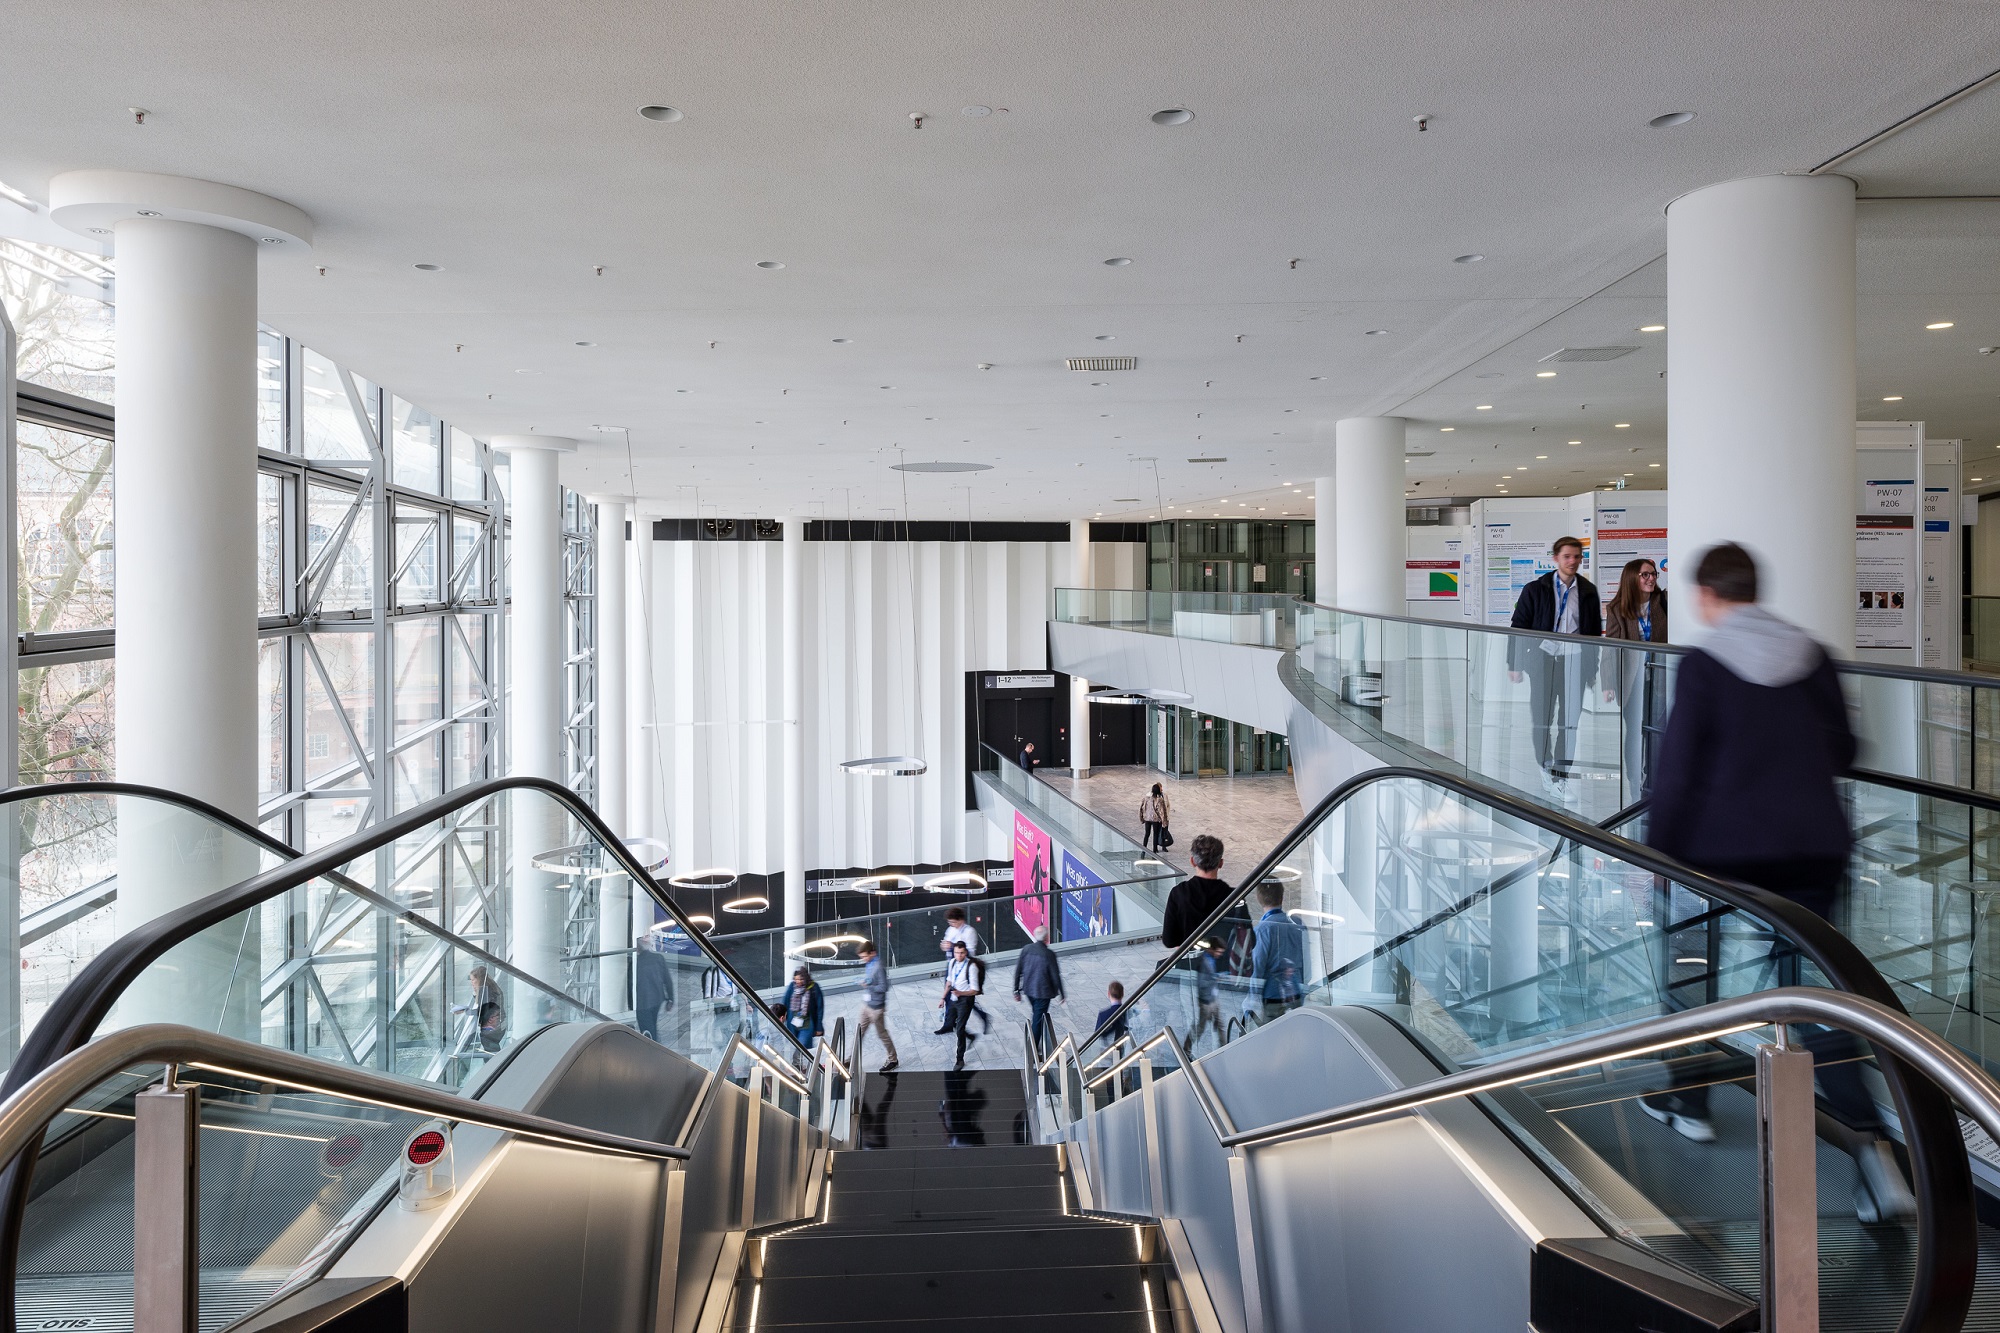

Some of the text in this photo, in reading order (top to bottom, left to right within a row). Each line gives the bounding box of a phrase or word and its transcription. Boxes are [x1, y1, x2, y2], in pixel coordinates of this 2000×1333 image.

[1876, 489, 1903, 497] PW-07
[1880, 500, 1900, 508] #206
[1016, 819, 1024, 835] Was
[1023, 825, 1034, 844] läuft?
[1065, 860, 1075, 880] Was
[42, 1318, 92, 1329] OTIS
